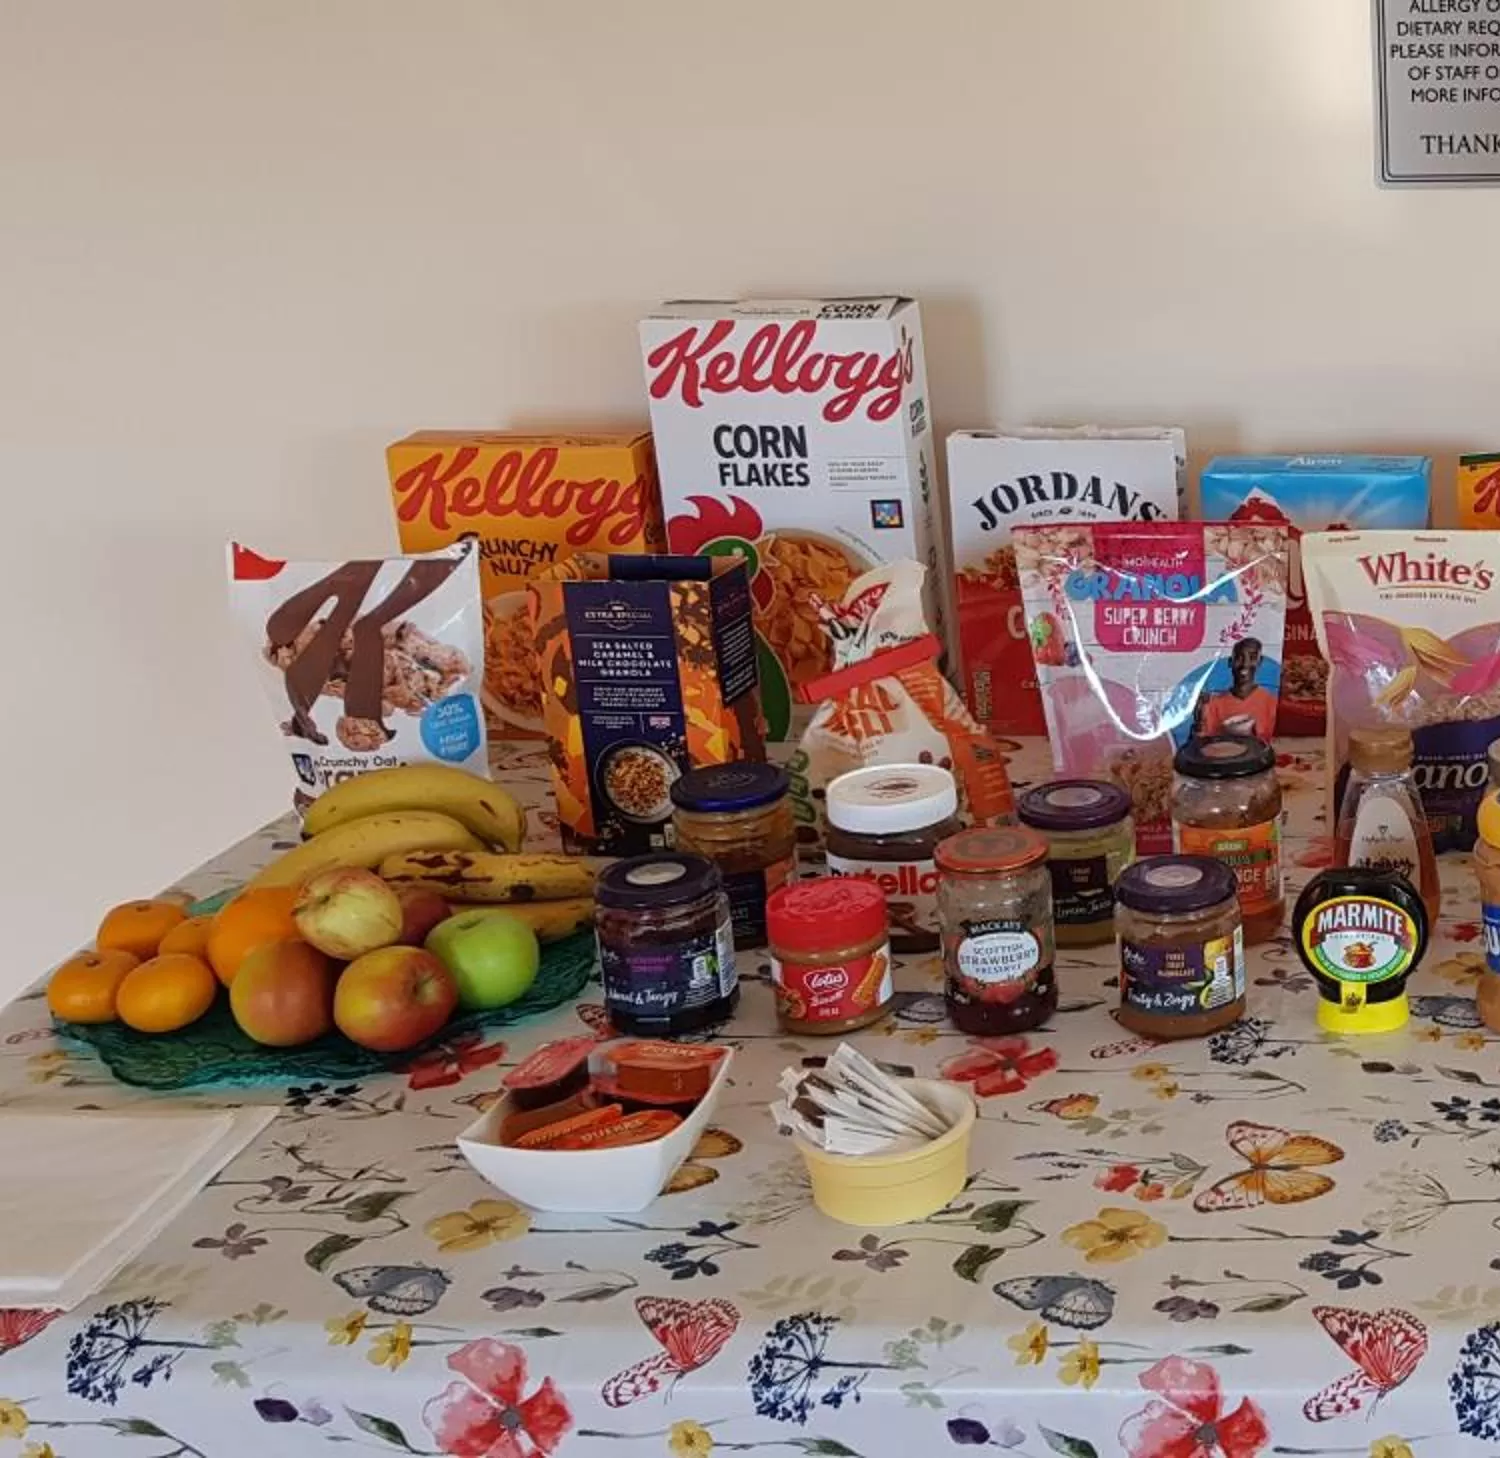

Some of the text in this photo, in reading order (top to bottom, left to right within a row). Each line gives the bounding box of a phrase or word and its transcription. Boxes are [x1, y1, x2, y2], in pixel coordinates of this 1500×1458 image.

[1409, 0, 1480, 13] ALLERGY
[1397, 21, 1463, 37] DIETARY
[1391, 43, 1445, 59] PLEASE
[1407, 66, 1431, 81] OF
[1435, 65, 1480, 81] STAFF
[1411, 88, 1457, 103] MORE
[822, 303, 881, 314] CORN
[713, 424, 808, 459] CORN
[718, 462, 810, 488] FLAKES
[490, 559, 537, 577] NUT
[1357, 550, 1495, 592] White's
[1104, 606, 1197, 626] SUPER BERRY
[1123, 627, 1178, 647] CRUNCH
[592, 642, 653, 650] SEA SALTED
[593, 651, 644, 659] CARAMEL
[578, 659, 672, 668] MILK CHOCOLATE
[318, 755, 398, 769] Crunchy Oat
[1318, 903, 1404, 936] MARMITE
[960, 947, 1037, 965] STRAWBERRY
[811, 973, 845, 989] Lotus
